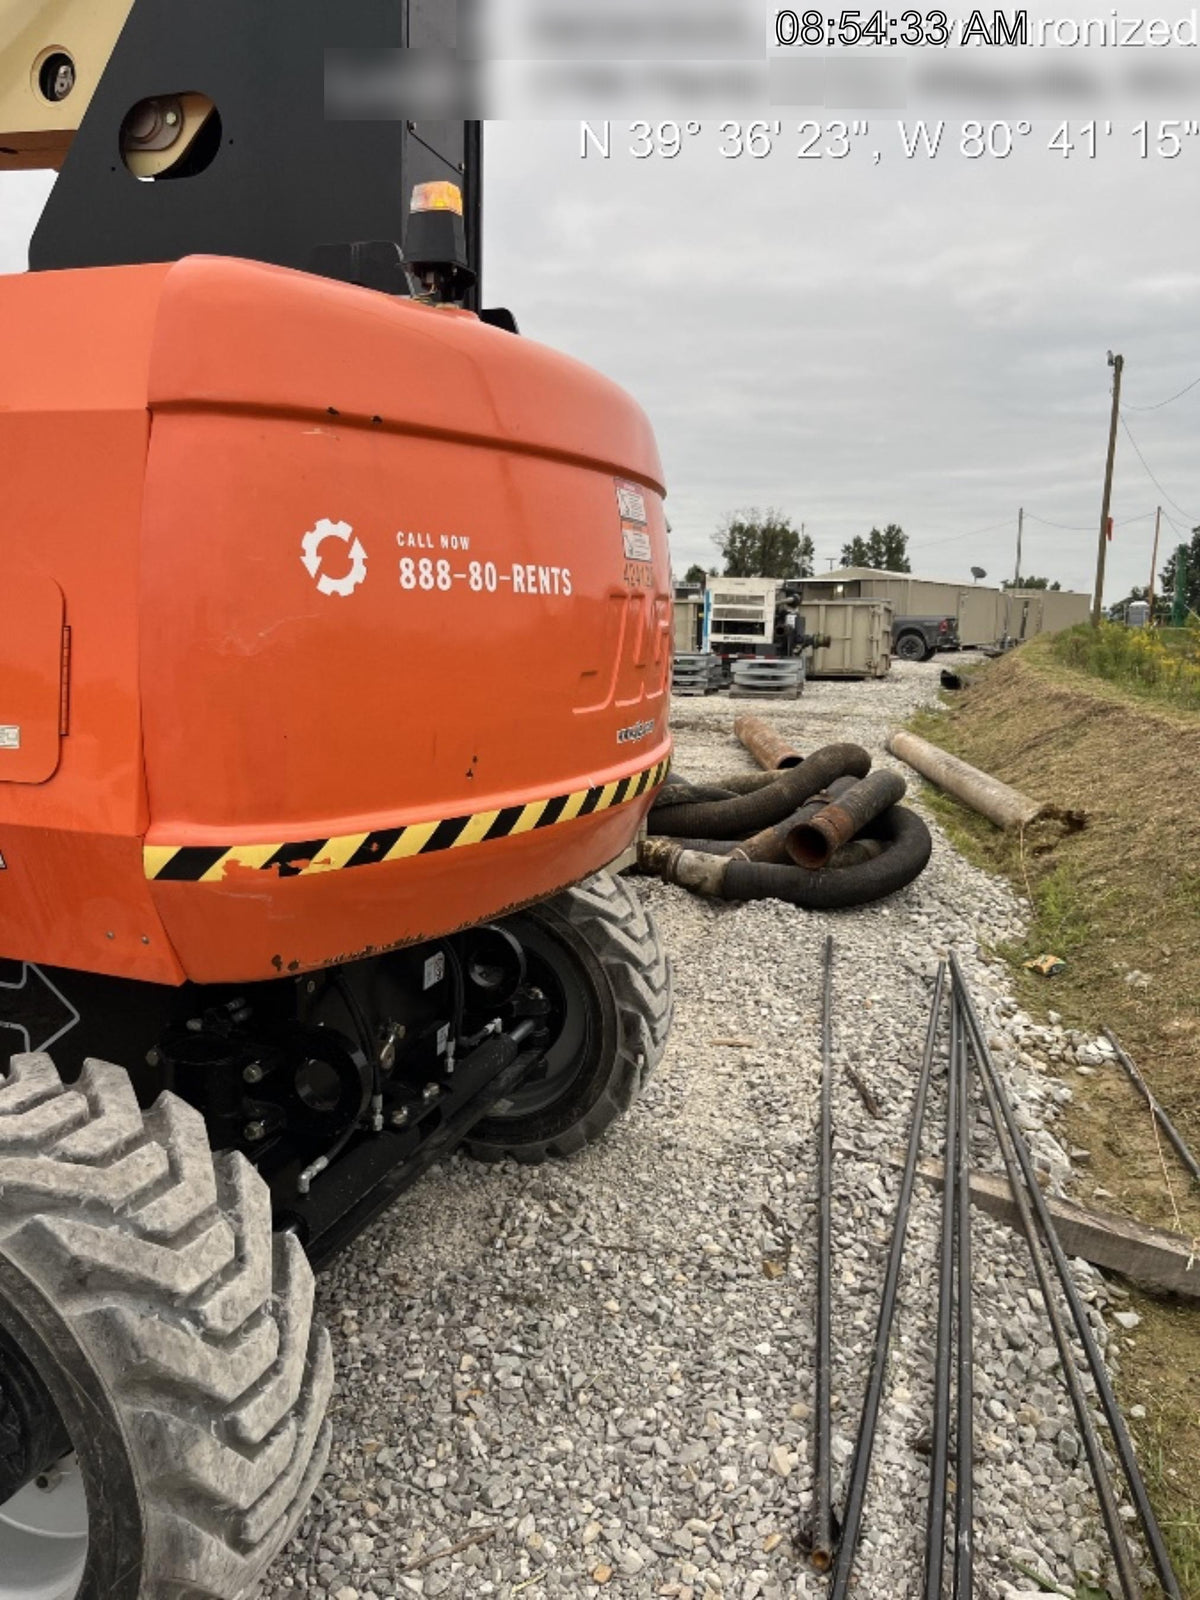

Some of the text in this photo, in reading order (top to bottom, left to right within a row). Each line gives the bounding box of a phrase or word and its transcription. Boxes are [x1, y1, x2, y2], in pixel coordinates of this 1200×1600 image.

[396, 531, 471, 551] CALL NOW
[399, 557, 573, 597] 888-80-RENTS
